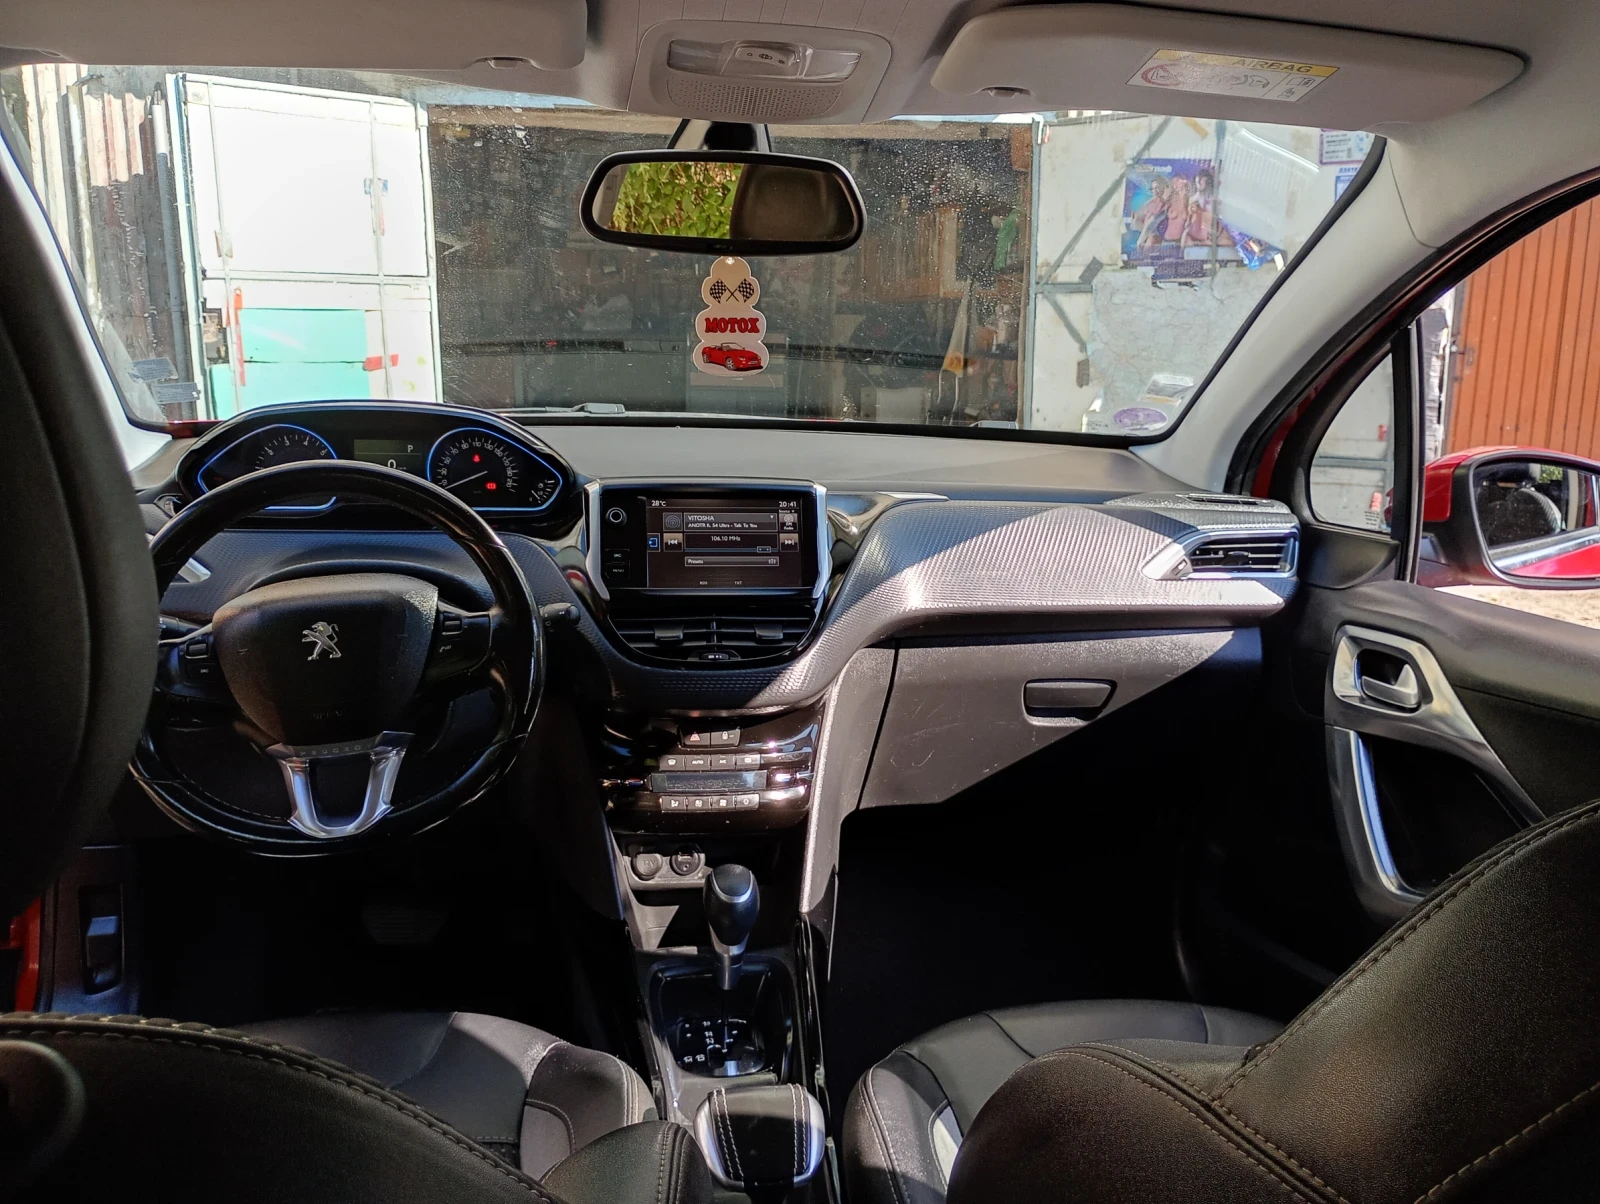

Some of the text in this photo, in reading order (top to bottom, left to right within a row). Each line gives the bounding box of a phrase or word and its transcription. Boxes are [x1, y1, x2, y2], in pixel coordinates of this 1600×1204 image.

[1231, 58, 1314, 73] AIRBAG
[705, 318, 760, 333] MOTOX
[407, 445, 414, 453] P
